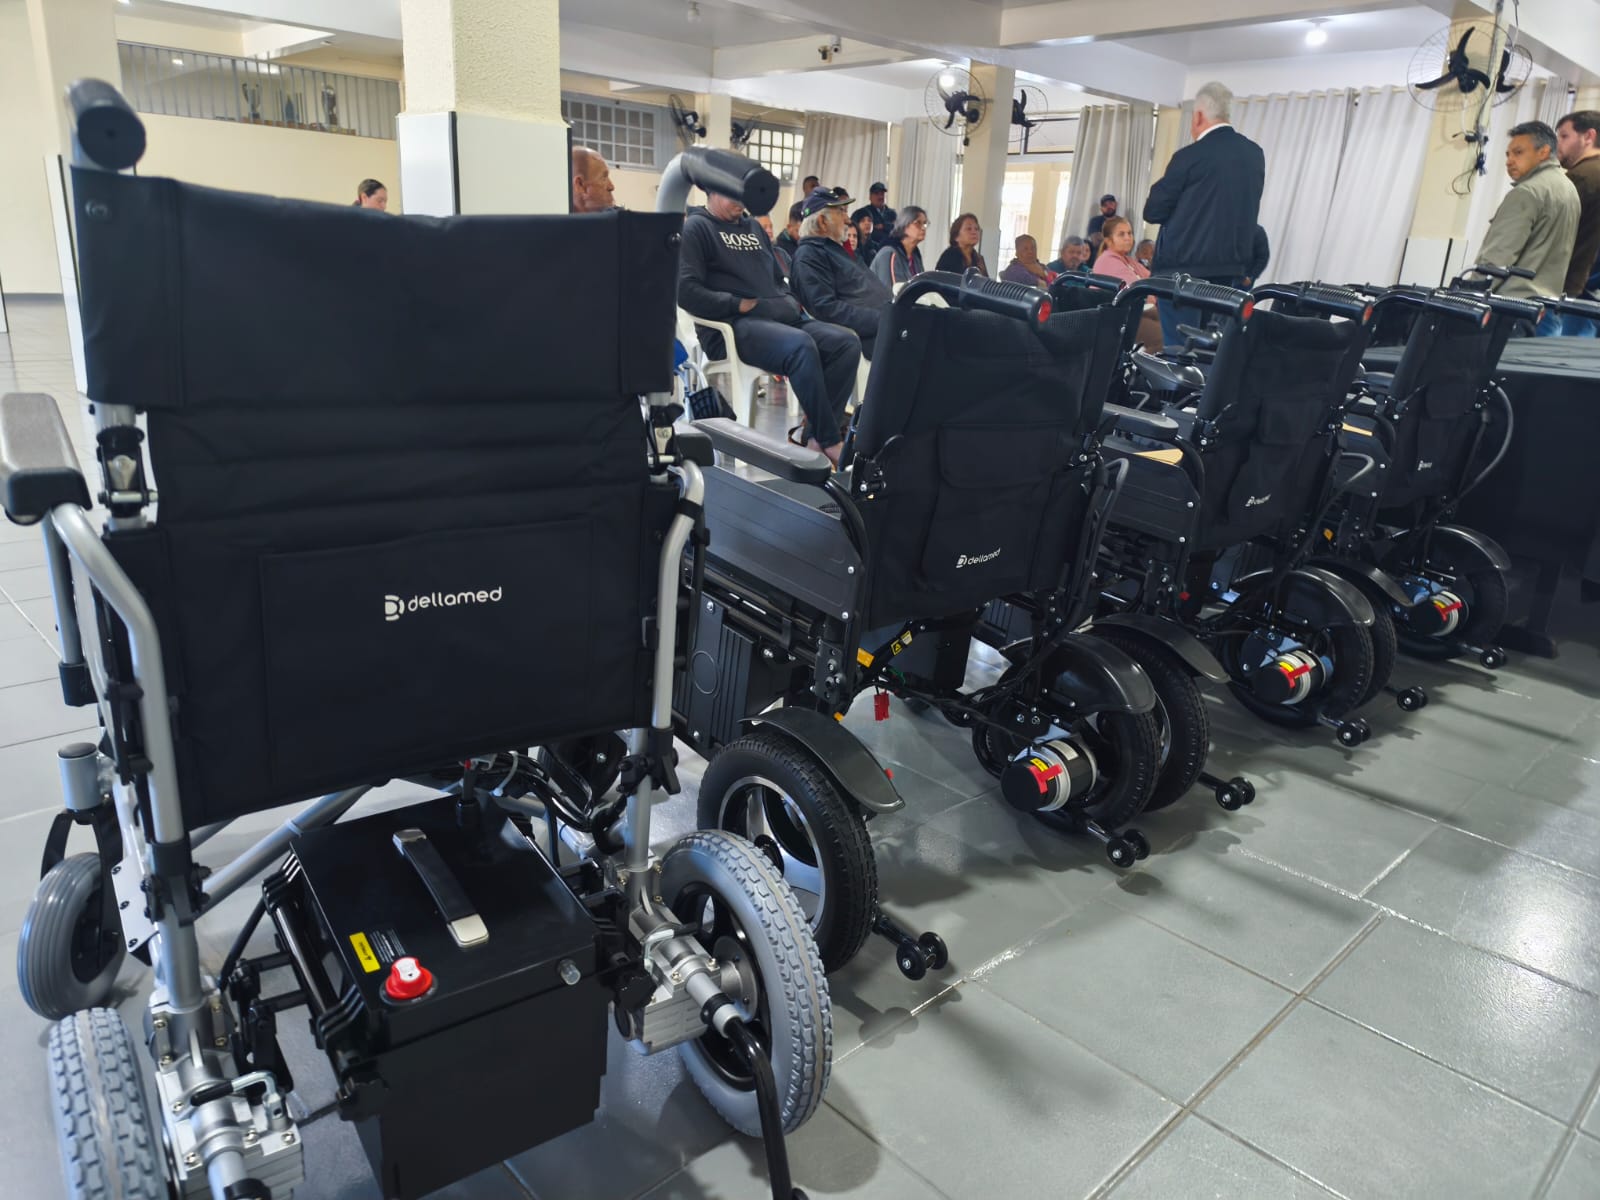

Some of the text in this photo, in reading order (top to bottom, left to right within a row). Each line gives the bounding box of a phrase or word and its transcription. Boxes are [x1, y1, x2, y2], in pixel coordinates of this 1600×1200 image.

[719, 231, 760, 247] BOSS
[967, 547, 1001, 565] dellamed
[408, 585, 503, 612] dellamed
